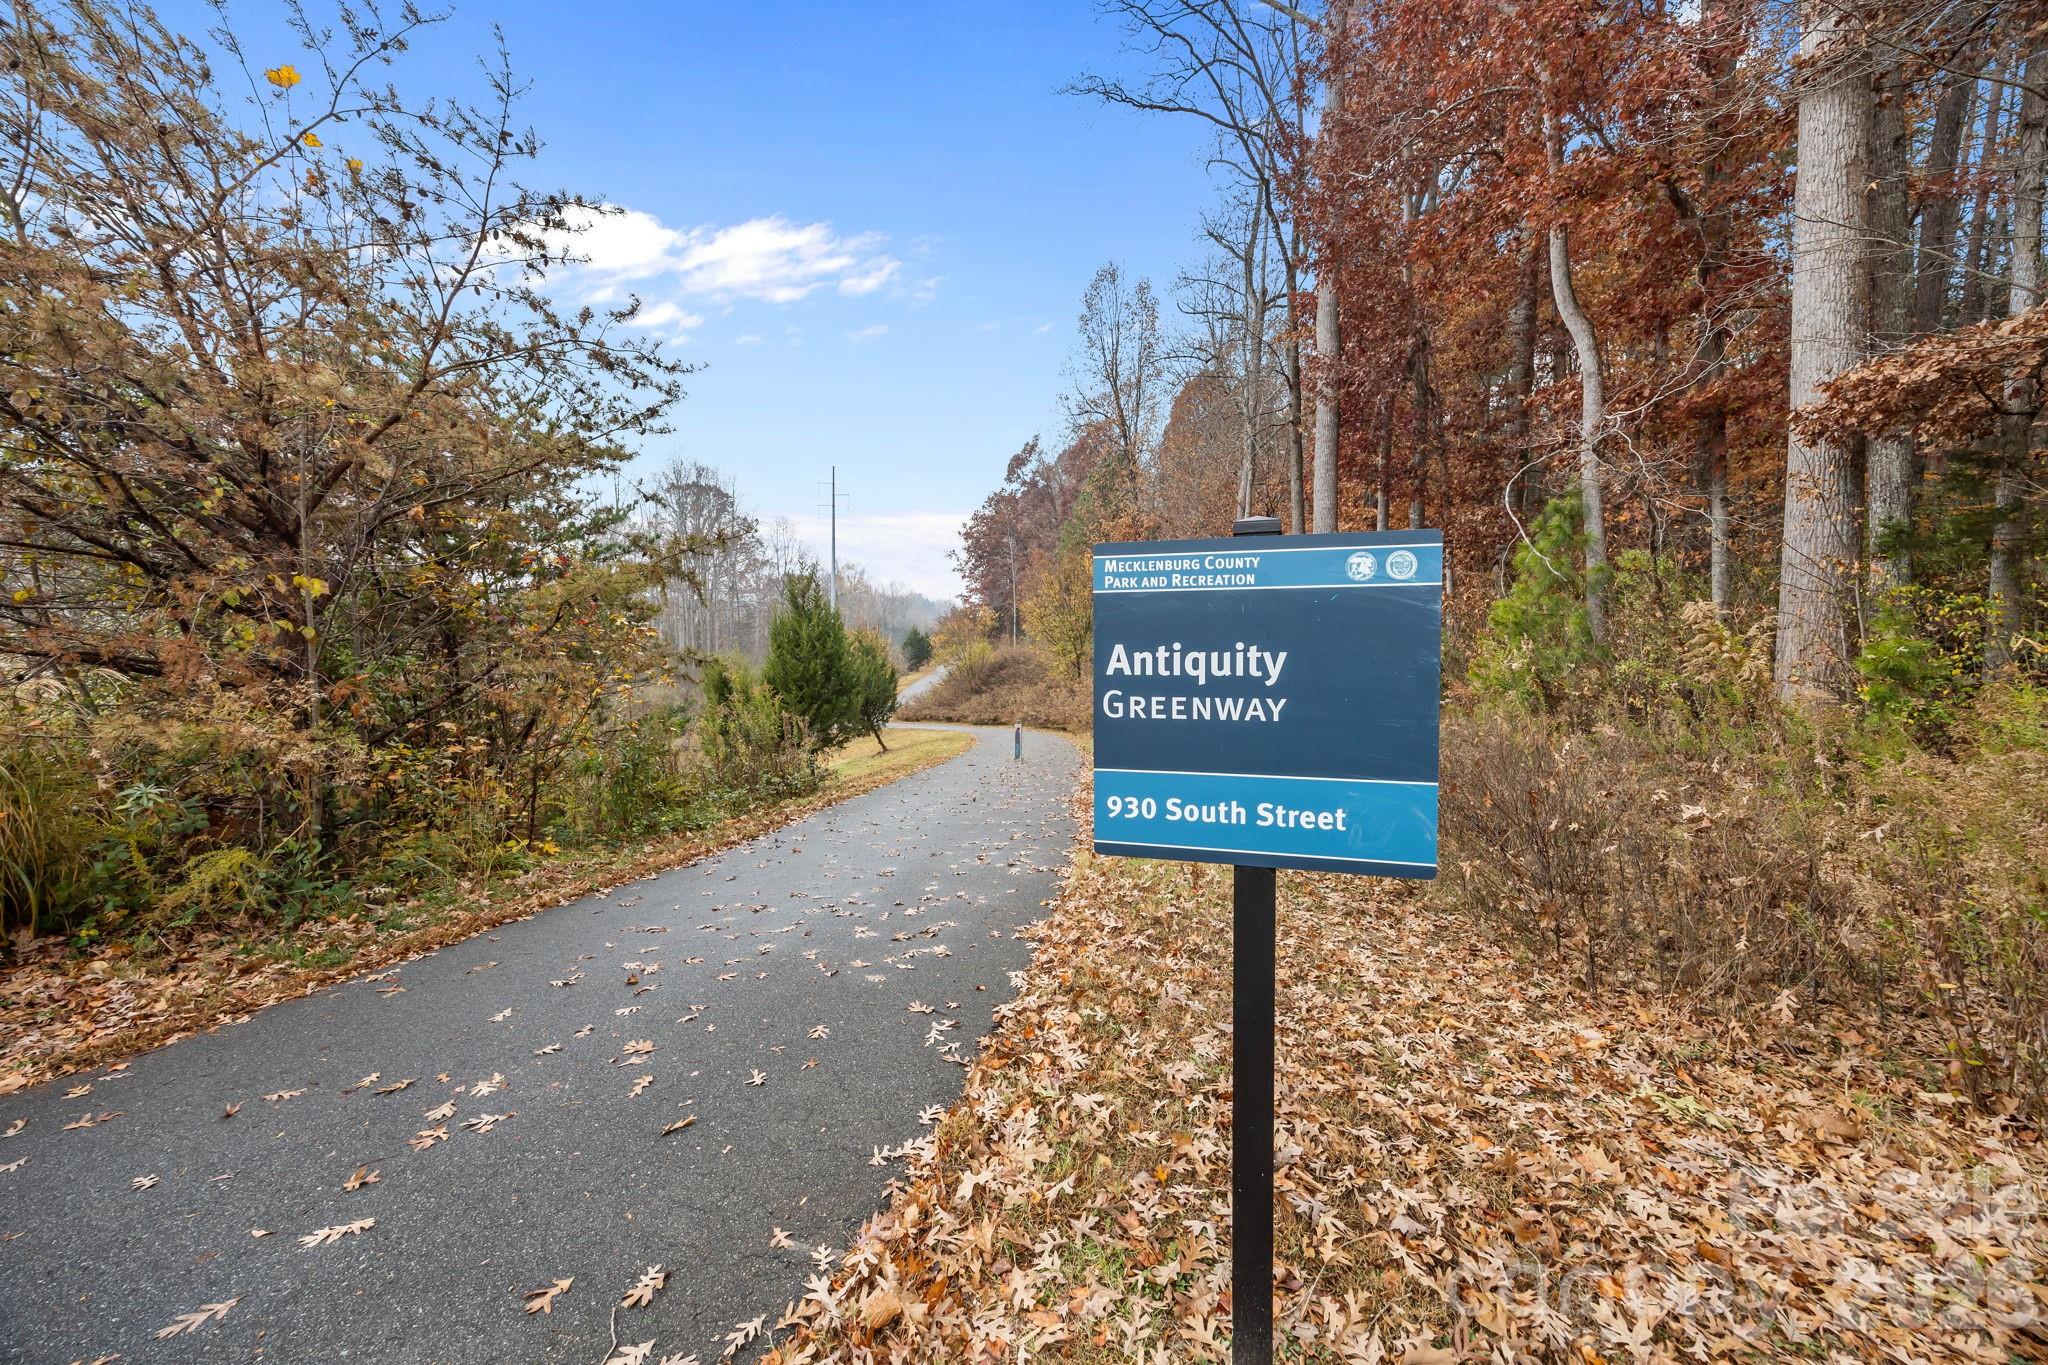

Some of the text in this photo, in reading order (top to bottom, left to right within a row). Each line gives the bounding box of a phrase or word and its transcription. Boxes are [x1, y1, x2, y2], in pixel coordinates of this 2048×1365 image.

[1104, 556, 1260, 573] MECKLENBURG COUNTY
[1104, 573, 1255, 589] PARK AND RECREATION
[1105, 641, 1288, 686] Antiquity
[1102, 689, 1287, 722] GREENWAY
[1106, 795, 1347, 831] 930 South Street
